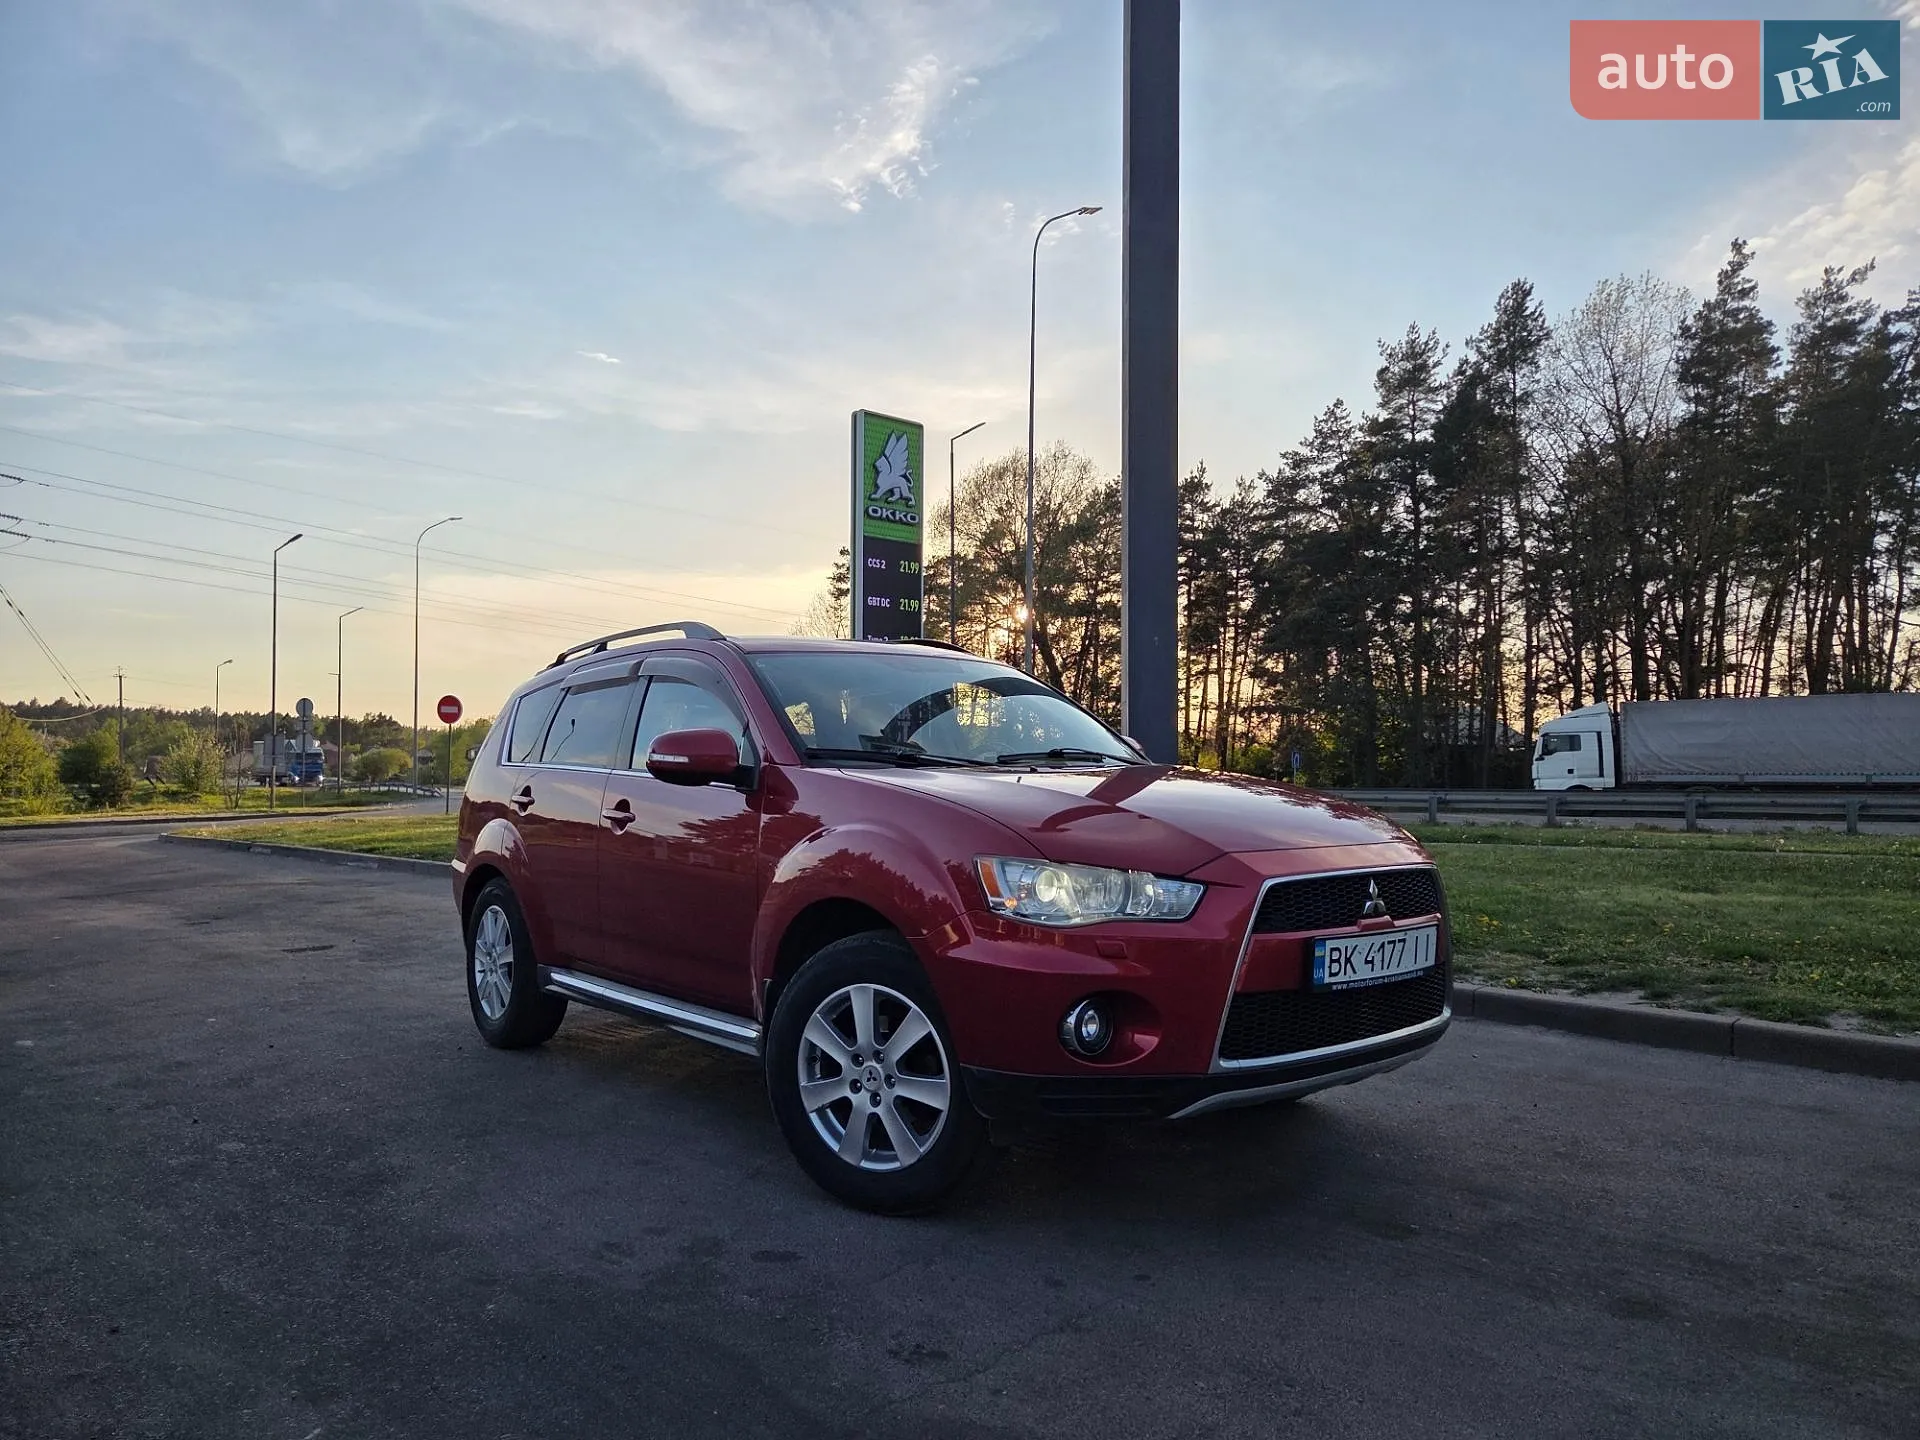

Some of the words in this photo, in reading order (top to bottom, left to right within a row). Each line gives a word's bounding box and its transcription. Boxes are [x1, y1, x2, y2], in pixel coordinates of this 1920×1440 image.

[869, 506, 919, 523] OKKO
[868, 558, 880, 568] CCS
[881, 560, 886, 569] 2
[900, 560, 919, 574] 21.99
[868, 596, 880, 607] GBT
[881, 598, 890, 608] DC
[900, 598, 919, 612] 21.99
[1328, 945, 1358, 978] BK
[1364, 938, 1407, 972] 4177
[1414, 934, 1430, 965] II
[1313, 968, 1324, 978] UA
